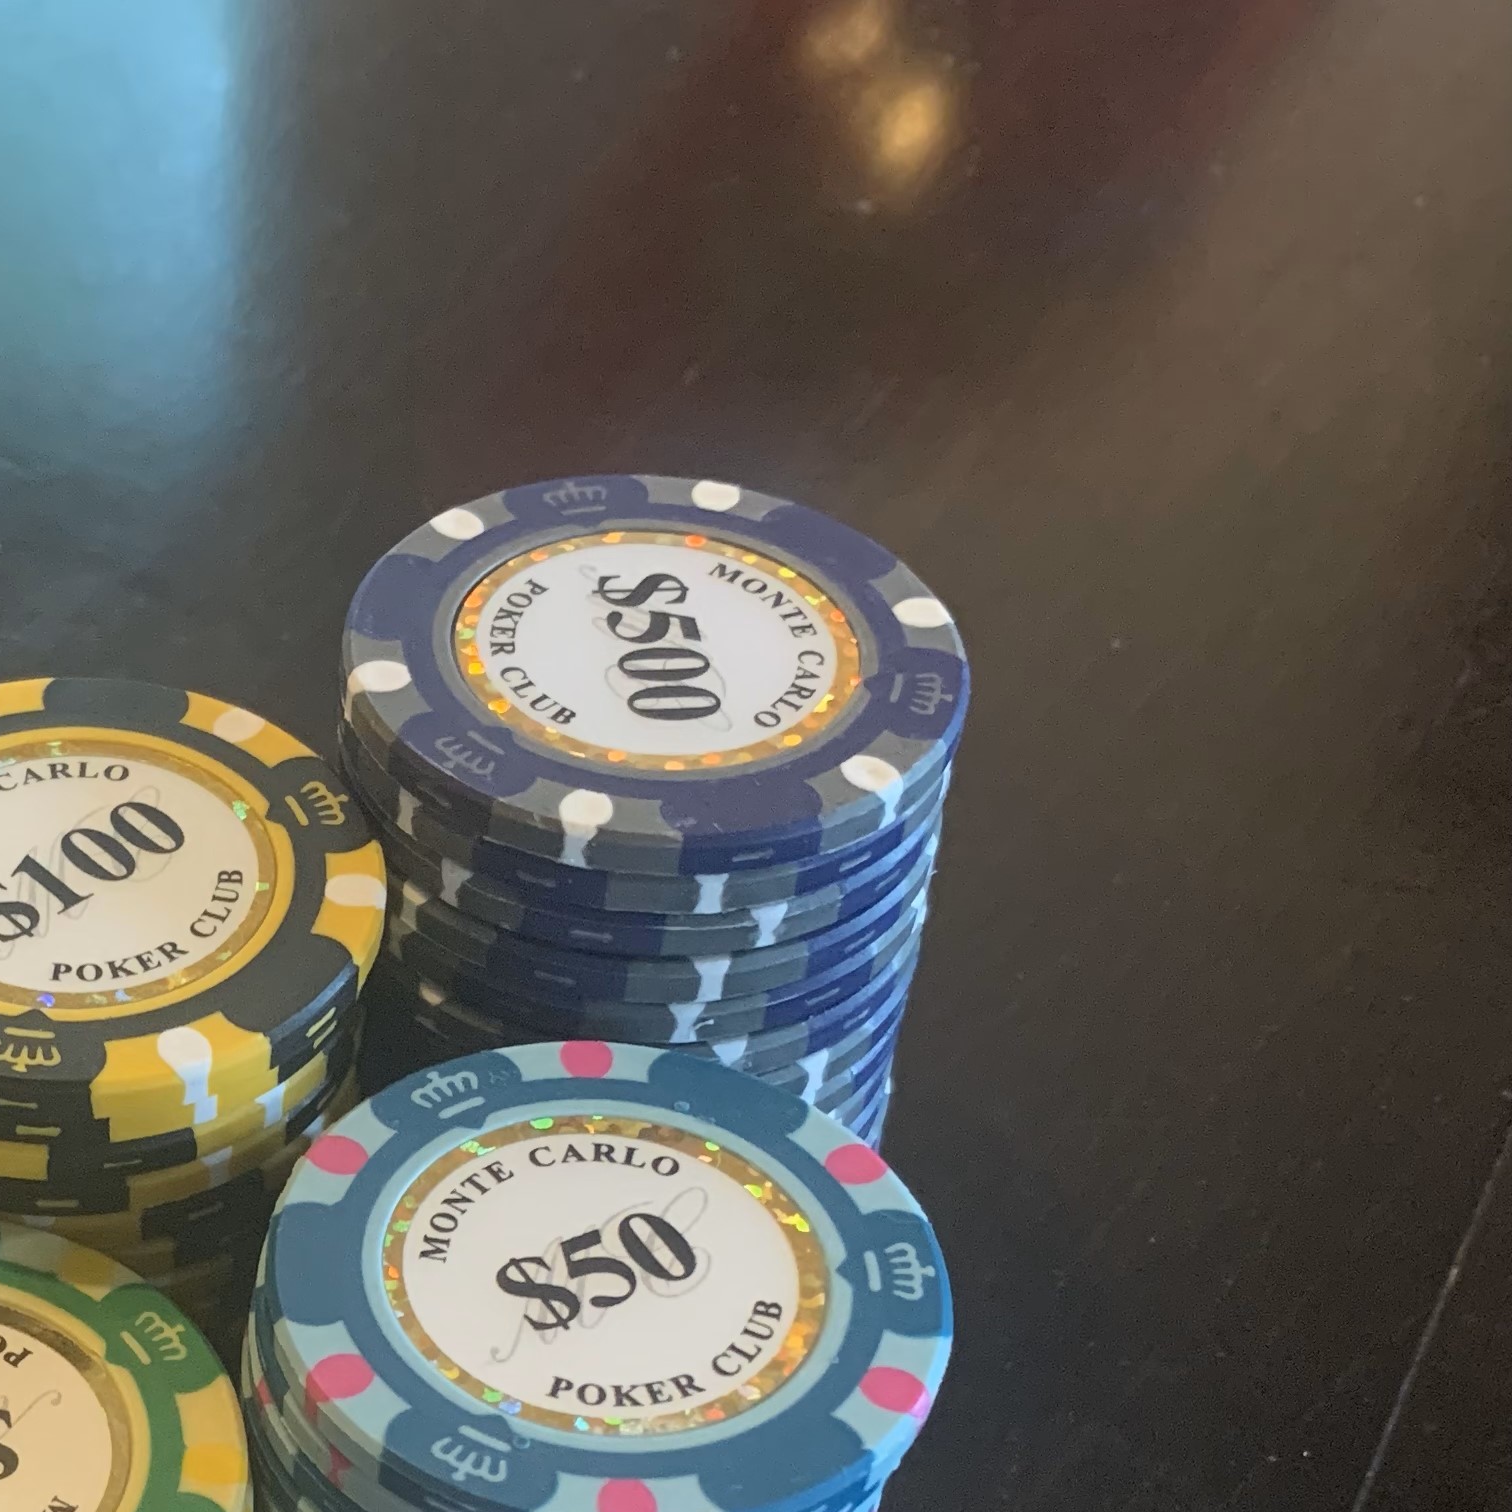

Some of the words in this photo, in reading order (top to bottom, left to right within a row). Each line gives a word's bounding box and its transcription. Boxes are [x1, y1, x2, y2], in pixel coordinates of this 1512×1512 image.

[490, 578, 549, 656] POKER
[592, 573, 721, 721] $500
[707, 562, 819, 639] MONTE
[500, 666, 577, 726] CLUB
[753, 649, 826, 728] CARLO
[49, 941, 189, 981] POKER
[189, 868, 244, 938] CLUB
[419, 1160, 514, 1263] MONTE
[528, 1142, 680, 1176] CARLO
[496, 1213, 697, 1331] $50
[545, 1374, 707, 1407] POKER
[712, 1298, 783, 1378] CLUB
